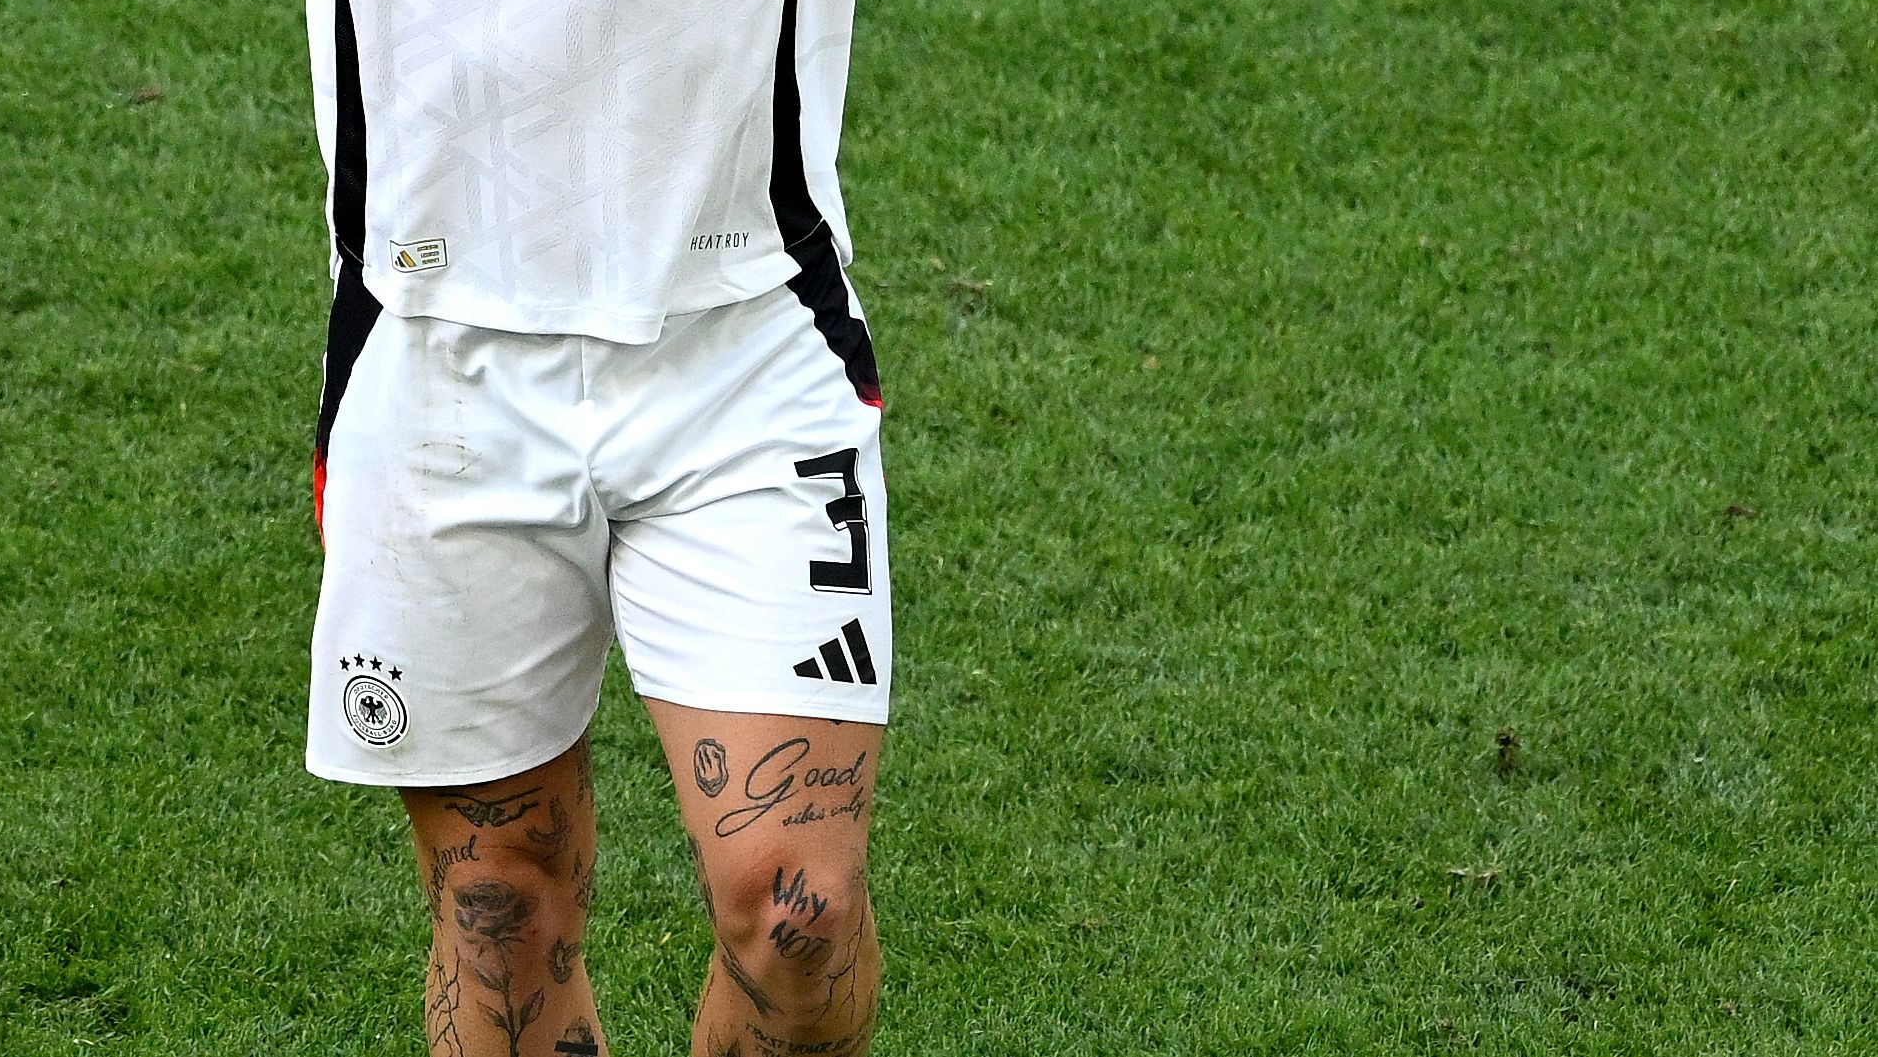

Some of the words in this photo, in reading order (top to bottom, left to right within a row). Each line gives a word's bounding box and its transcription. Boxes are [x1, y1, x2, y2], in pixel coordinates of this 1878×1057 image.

[793, 447, 873, 595] 3
[715, 737, 867, 838] Good
[772, 866, 828, 927] Why
